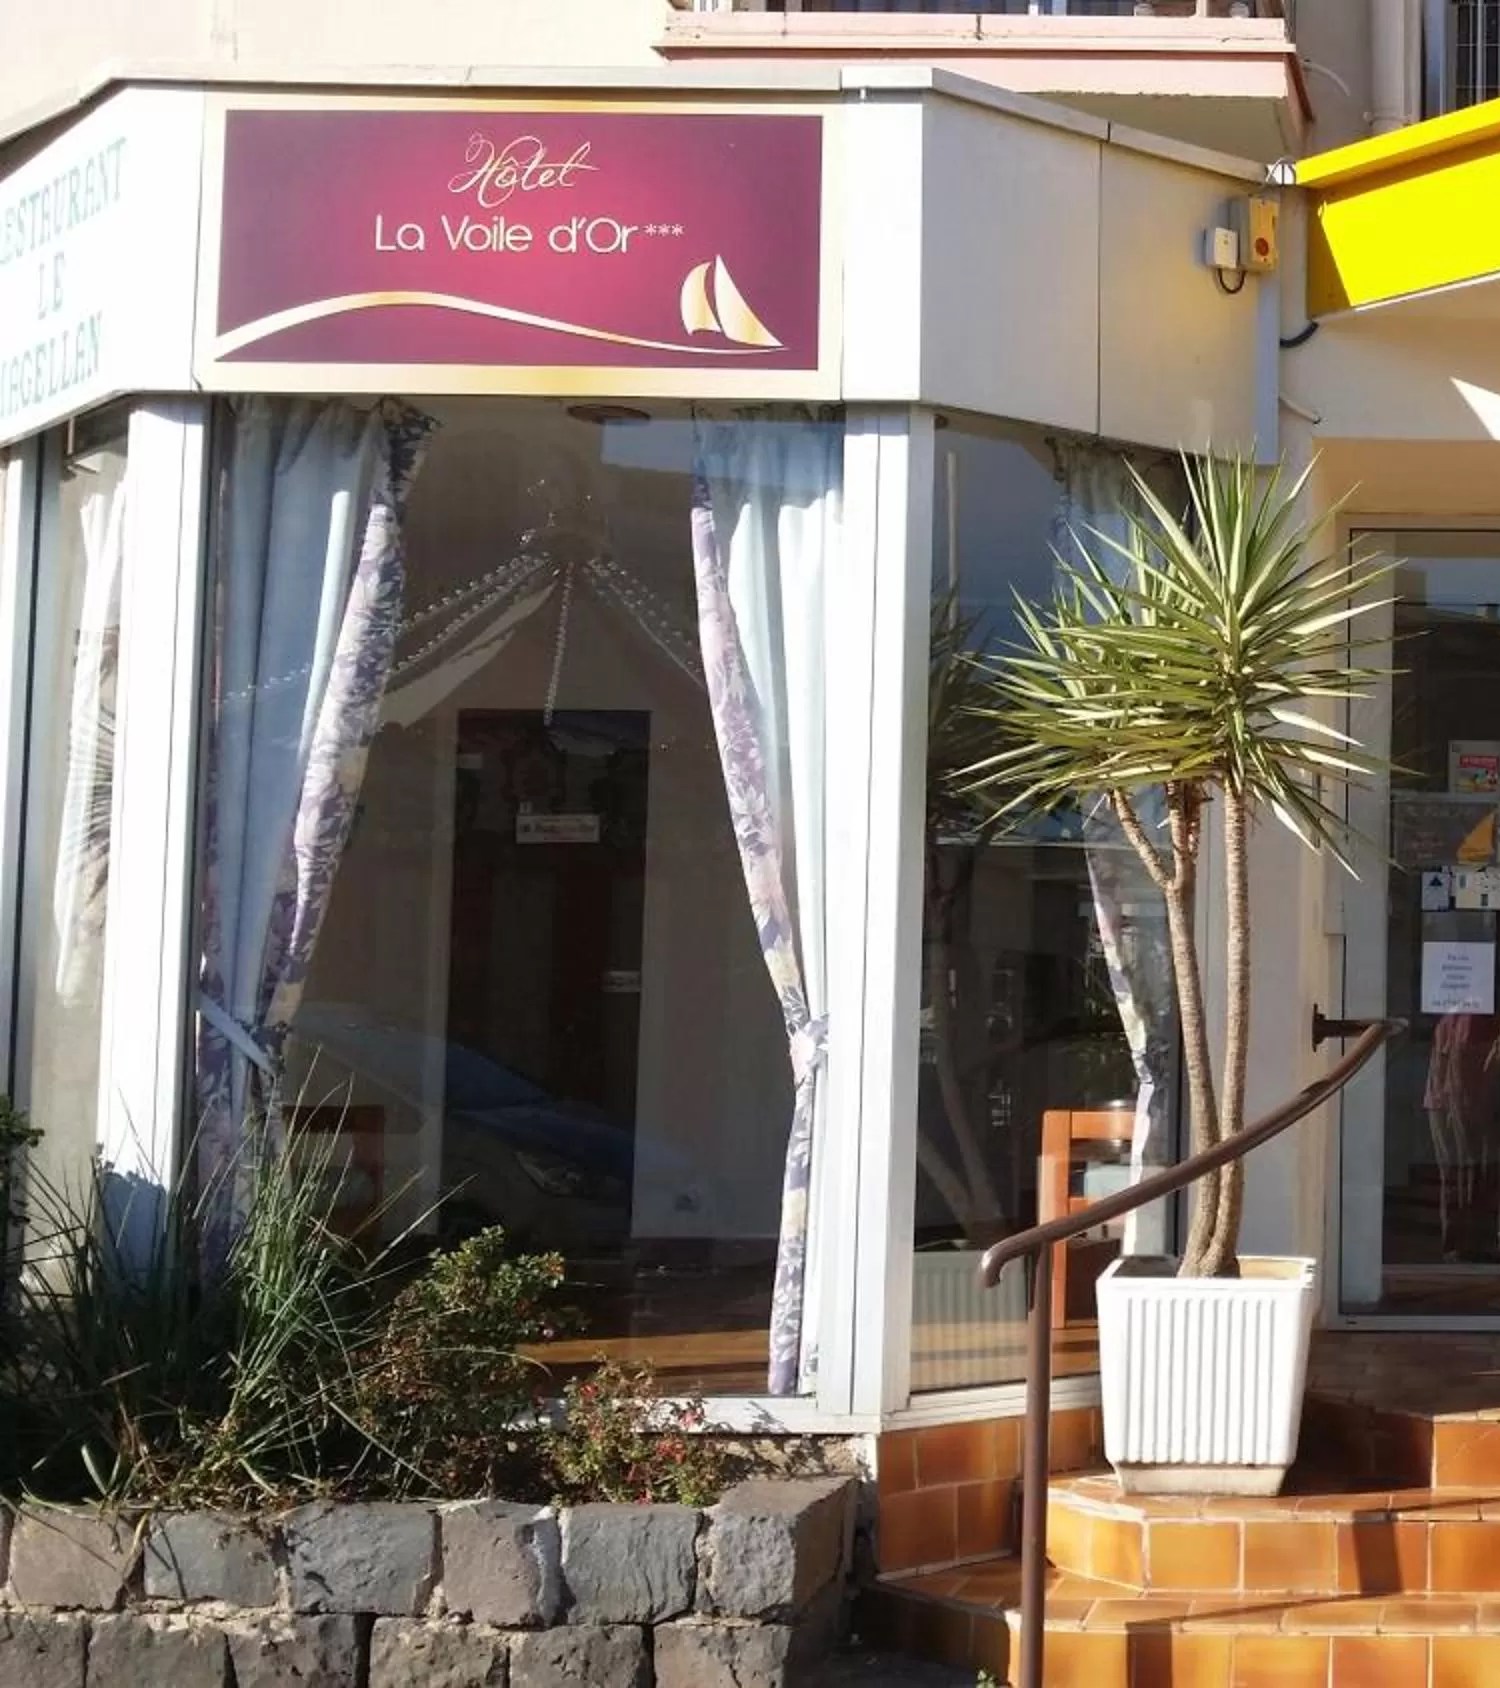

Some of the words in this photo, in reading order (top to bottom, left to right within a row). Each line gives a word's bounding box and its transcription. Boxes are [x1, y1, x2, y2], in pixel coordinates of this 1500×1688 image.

[447, 132, 601, 208] Hôtel
[374, 214, 425, 252] La
[441, 215, 533, 252] Voile
[37, 250, 66, 321] LE
